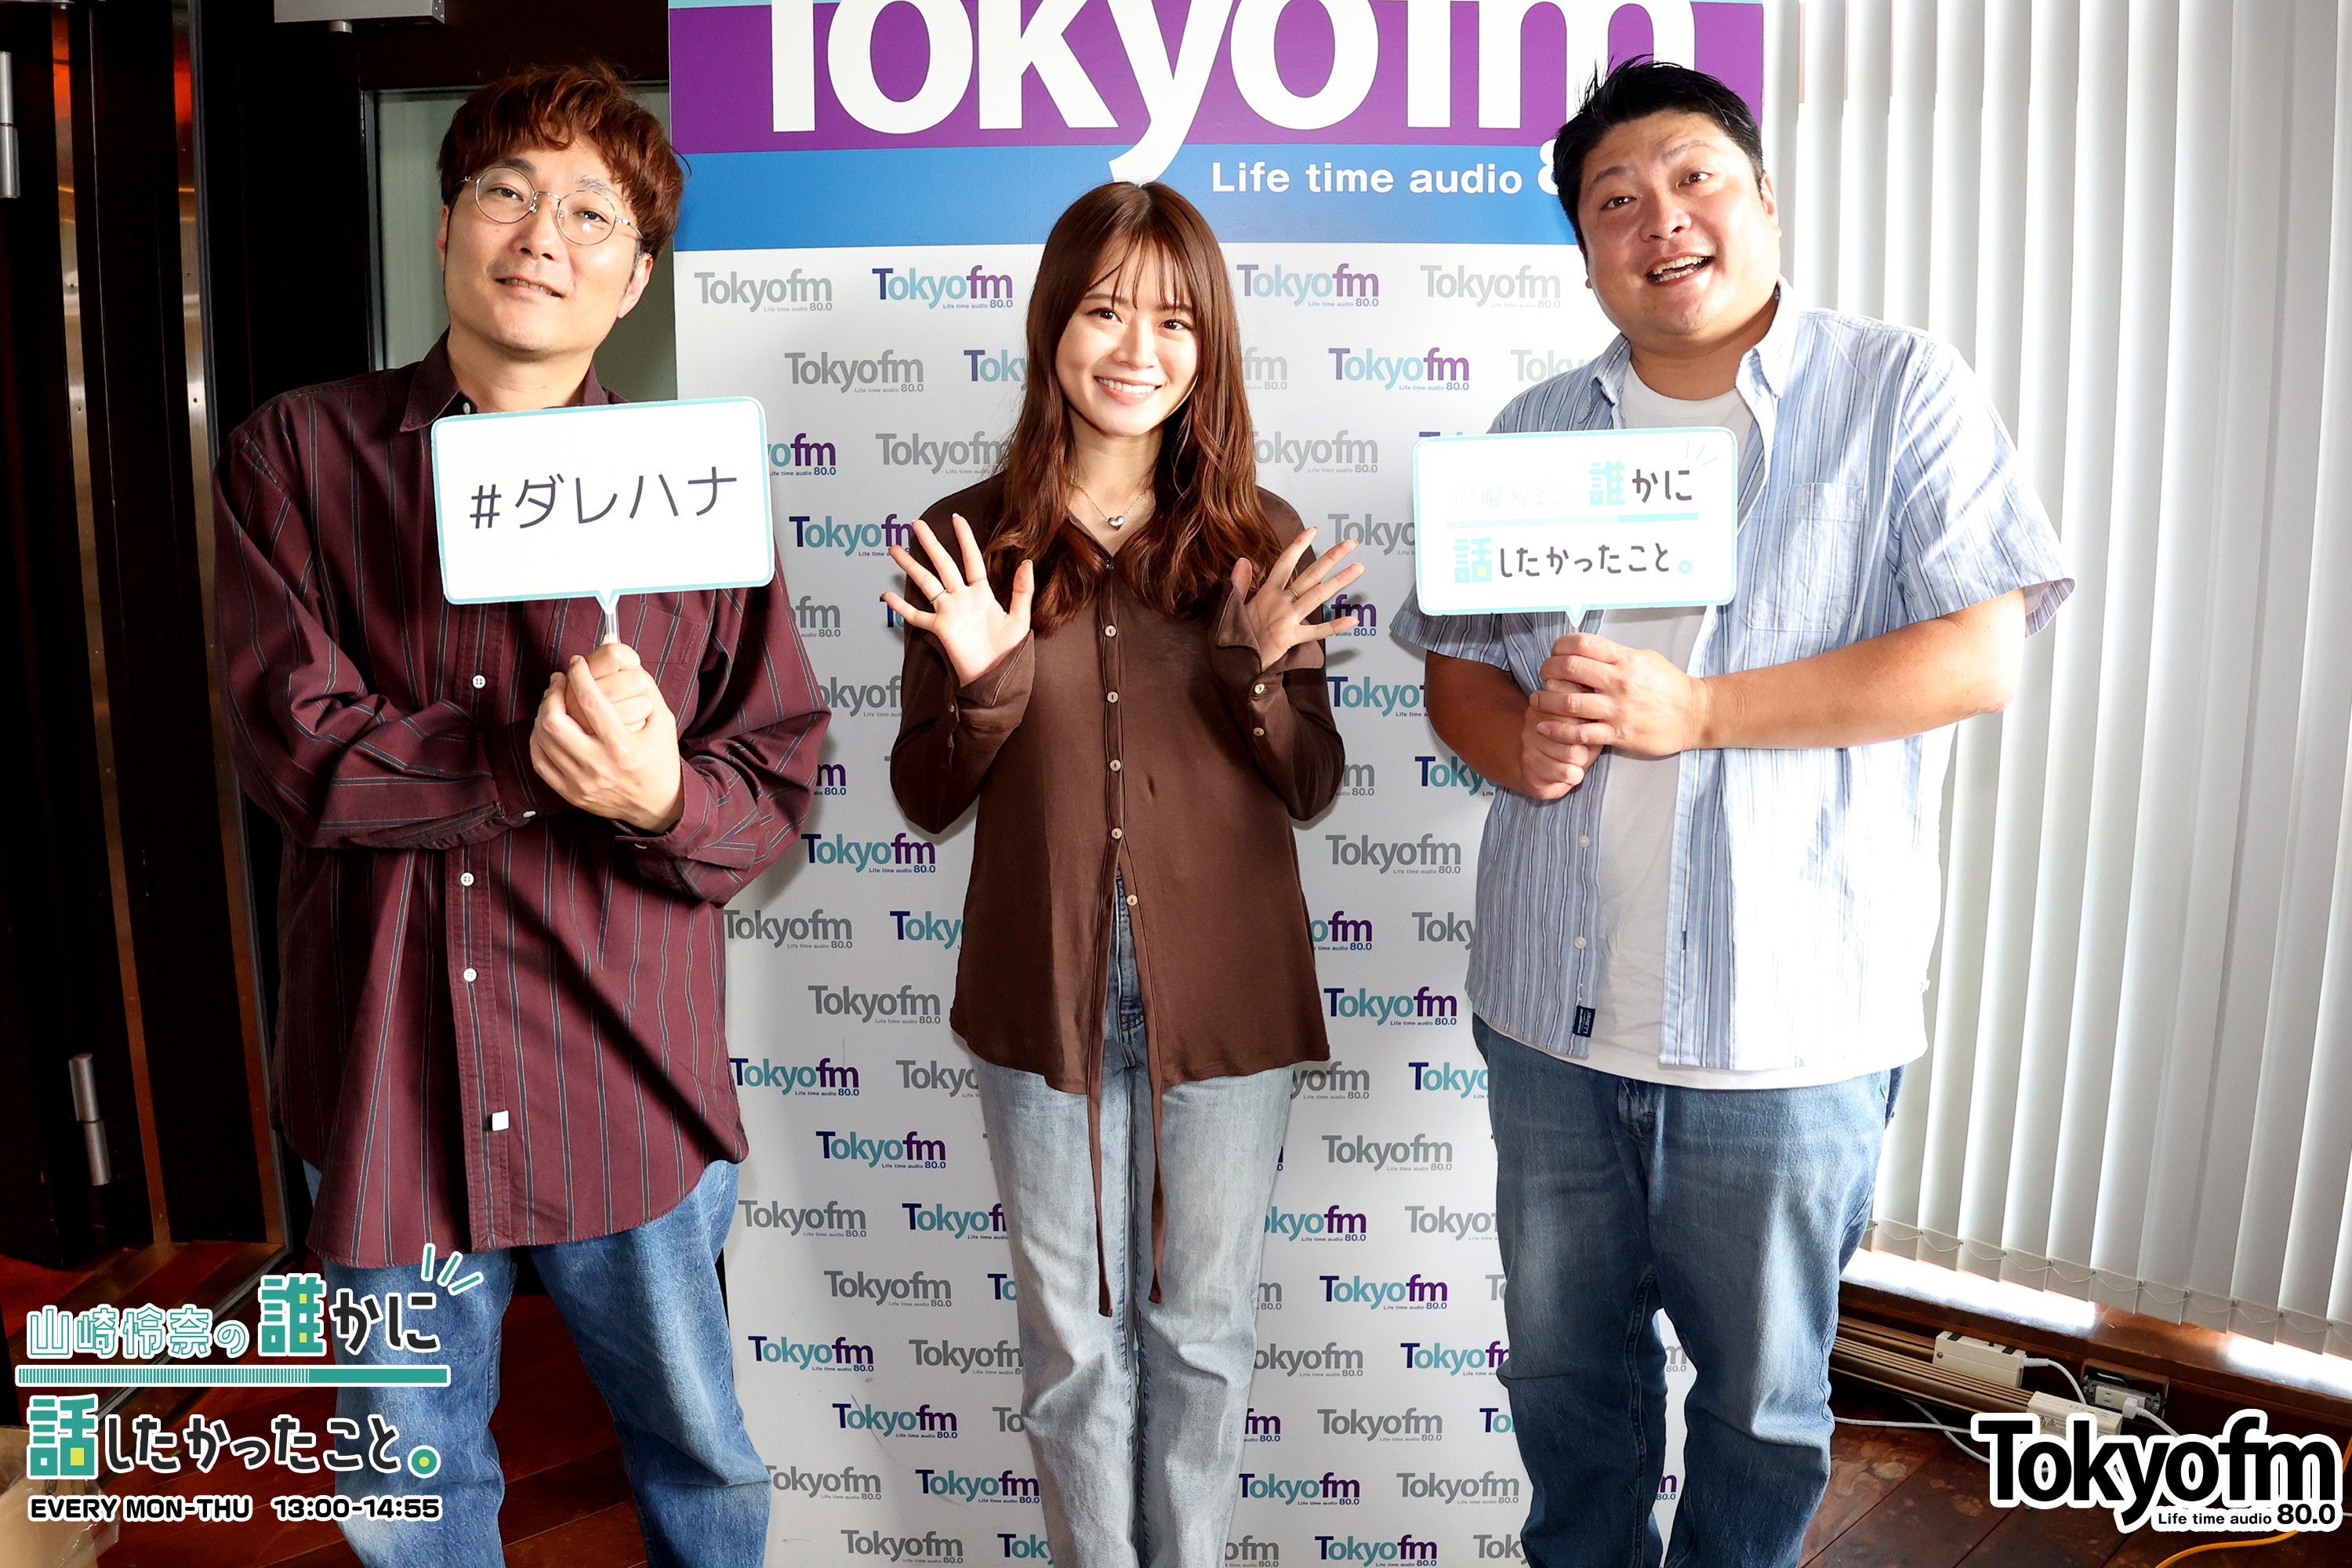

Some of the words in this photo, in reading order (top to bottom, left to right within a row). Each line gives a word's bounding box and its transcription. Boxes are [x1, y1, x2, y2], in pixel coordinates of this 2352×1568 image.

[1213, 162, 1290, 194] Life
[1306, 162, 1394, 194] time
[1409, 163, 1523, 194] audio
[695, 269, 832, 312] Tokyofm
[873, 265, 1013, 310] Tokyofm
[1237, 263, 1379, 307] Tokyofm
[1356, 298, 1378, 307] 80.0
[990, 299, 1013, 308] 80.0
[785, 350, 924, 394] Tokyofm
[1265, 382, 1287, 390] 80.0
[1329, 347, 1468, 390] Tokyofm
[1446, 382, 1469, 390] 80.0
[901, 383, 924, 392] 80.0
[814, 467, 837, 476] 80.0
[1355, 464, 1377, 473] 80.0
[1454, 536, 1693, 583] 話したかったこと。
[1354, 627, 1377, 637] 80.0
[824, 787, 847, 796] 80.0
[1352, 787, 1374, 797] 80.0
[801, 833, 935, 873] Tokyofm
[1326, 833, 1461, 874] Tokyofm
[724, 909, 853, 949] Tokyofm
[1350, 942, 1373, 951] 80.0
[808, 985, 941, 1024] Tokyofm
[1323, 986, 1457, 1025] Tokyofm
[816, 1131, 946, 1169] Tokyofm
[1322, 1133, 1452, 1171] Tokyofm
[739, 1200, 866, 1237] Tokyofm
[824, 1271, 952, 1307] Tokyofm
[1319, 1274, 1447, 1309] Tokyofm
[748, 1336, 874, 1373] Tokyofm
[1666, 1364, 1686, 1373] 80.0
[833, 1403, 957, 1439] Tokyofm
[1317, 1407, 1443, 1442] Tokyofm
[916, 1470, 1040, 1504] Tokyofm
[1239, 1472, 1360, 1504] Tokyofm
[1396, 1471, 1519, 1504] Tokyofm
[841, 1530, 963, 1563] Tokyofm
[1316, 1534, 1437, 1567] Tokyofm
